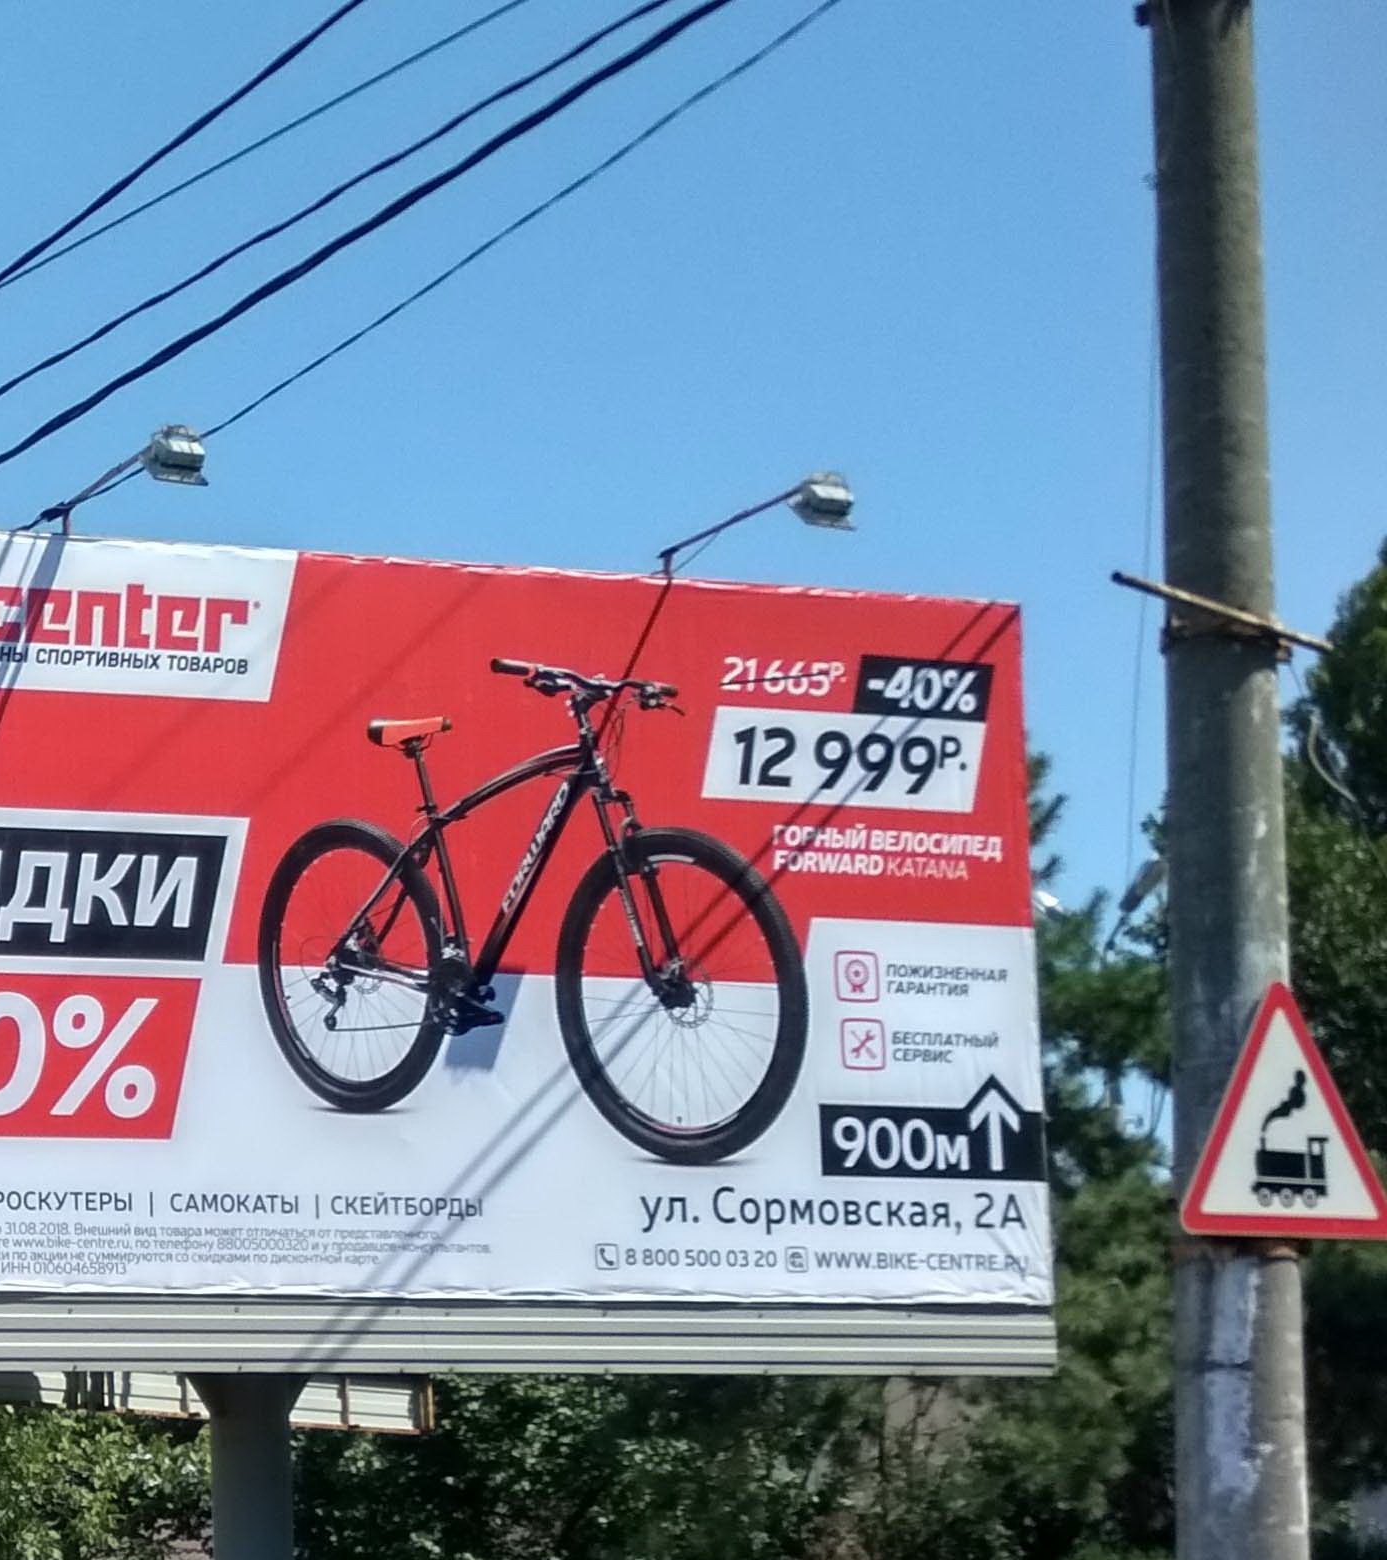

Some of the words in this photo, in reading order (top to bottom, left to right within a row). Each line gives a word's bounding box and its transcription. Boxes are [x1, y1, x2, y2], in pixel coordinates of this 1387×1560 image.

[35, 648, 161, 670] СПОРТИВНЫХ
[166, 654, 249, 675] ТОВАРОВ
[867, 664, 979, 714] -40%
[733, 725, 798, 788] 12
[773, 823, 867, 850] ГОРНЫЙ
[871, 831, 1004, 862] ВЕЛОСИПЕД
[773, 850, 884, 876] FORWARD
[886, 857, 970, 881] KATANA
[885, 963, 1009, 984] ПОЖИЗНЕННАЯ
[886, 980, 970, 997] ГАРАНТИЯ
[891, 1030, 1000, 1049] БЕСПЛАТНЫЙ
[892, 1048, 954, 1064] СЕРВИС
[169, 1192, 300, 1215] САМОКАТЫ
[330, 1192, 485, 1221] СКЕЙТБОРДЫ
[639, 1194, 702, 1233] ул.
[712, 1186, 963, 1236] Сормовская,
[973, 1191, 1028, 1230] 2А
[74, 1222, 132, 1237] Внешний
[133, 1226, 157, 1238] вид
[159, 1226, 203, 1239] товара
[135, 1239, 151, 1250] по
[152, 1238, 215, 1251] телефону
[1, 1262, 32, 1274] ИНН
[12, 1252, 28, 1262] по
[30, 1252, 69, 1263] акции
[70, 1252, 86, 1262] не
[87, 1252, 173, 1264] суммируются
[253, 1254, 269, 1264] по
[625, 1248, 638, 1267] 8
[641, 1248, 681, 1267] 800
[684, 1249, 722, 1267] 500
[726, 1249, 750, 1268] 03
[754, 1250, 779, 1268] 20
